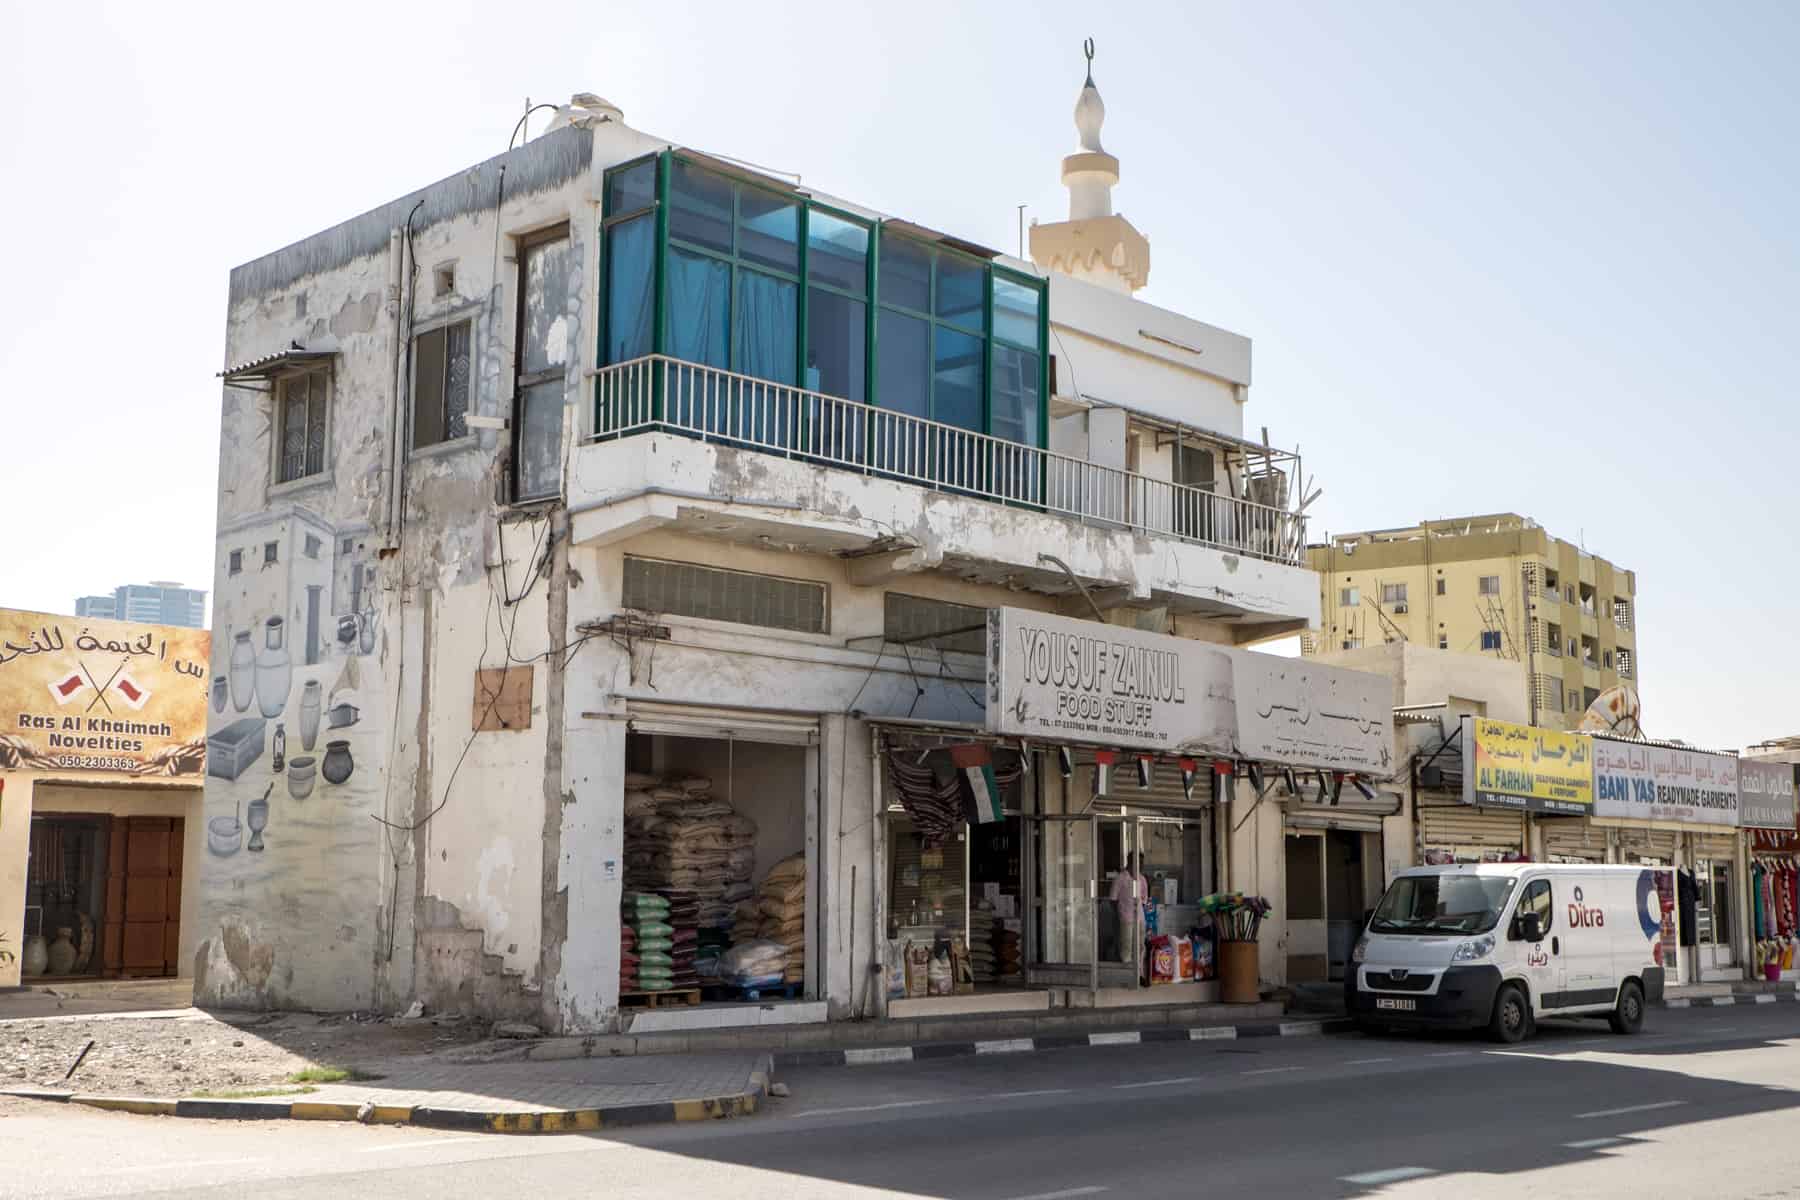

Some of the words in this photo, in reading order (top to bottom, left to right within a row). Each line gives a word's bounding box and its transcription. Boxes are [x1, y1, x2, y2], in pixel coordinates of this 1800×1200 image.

[1019, 626, 1107, 692] YOUSUF
[1111, 642, 1185, 704] ZAINUL
[1056, 691, 1102, 720] FOOD
[1105, 698, 1152, 727] STUFF
[18, 713, 55, 729] Ras
[62, 716, 81, 730] Al
[87, 718, 171, 736] Khaimah
[49, 733, 142, 752] Novelties
[59, 755, 135, 769] 050-2303363
[1480, 768, 1493, 788] AL
[1495, 768, 1534, 793] FARHAN
[1598, 775, 1629, 801] BANI
[1631, 778, 1656, 804] YAS
[1656, 785, 1700, 807] READYMADE
[1700, 789, 1737, 811] GARMENTS
[1568, 903, 1604, 928] Ditra
